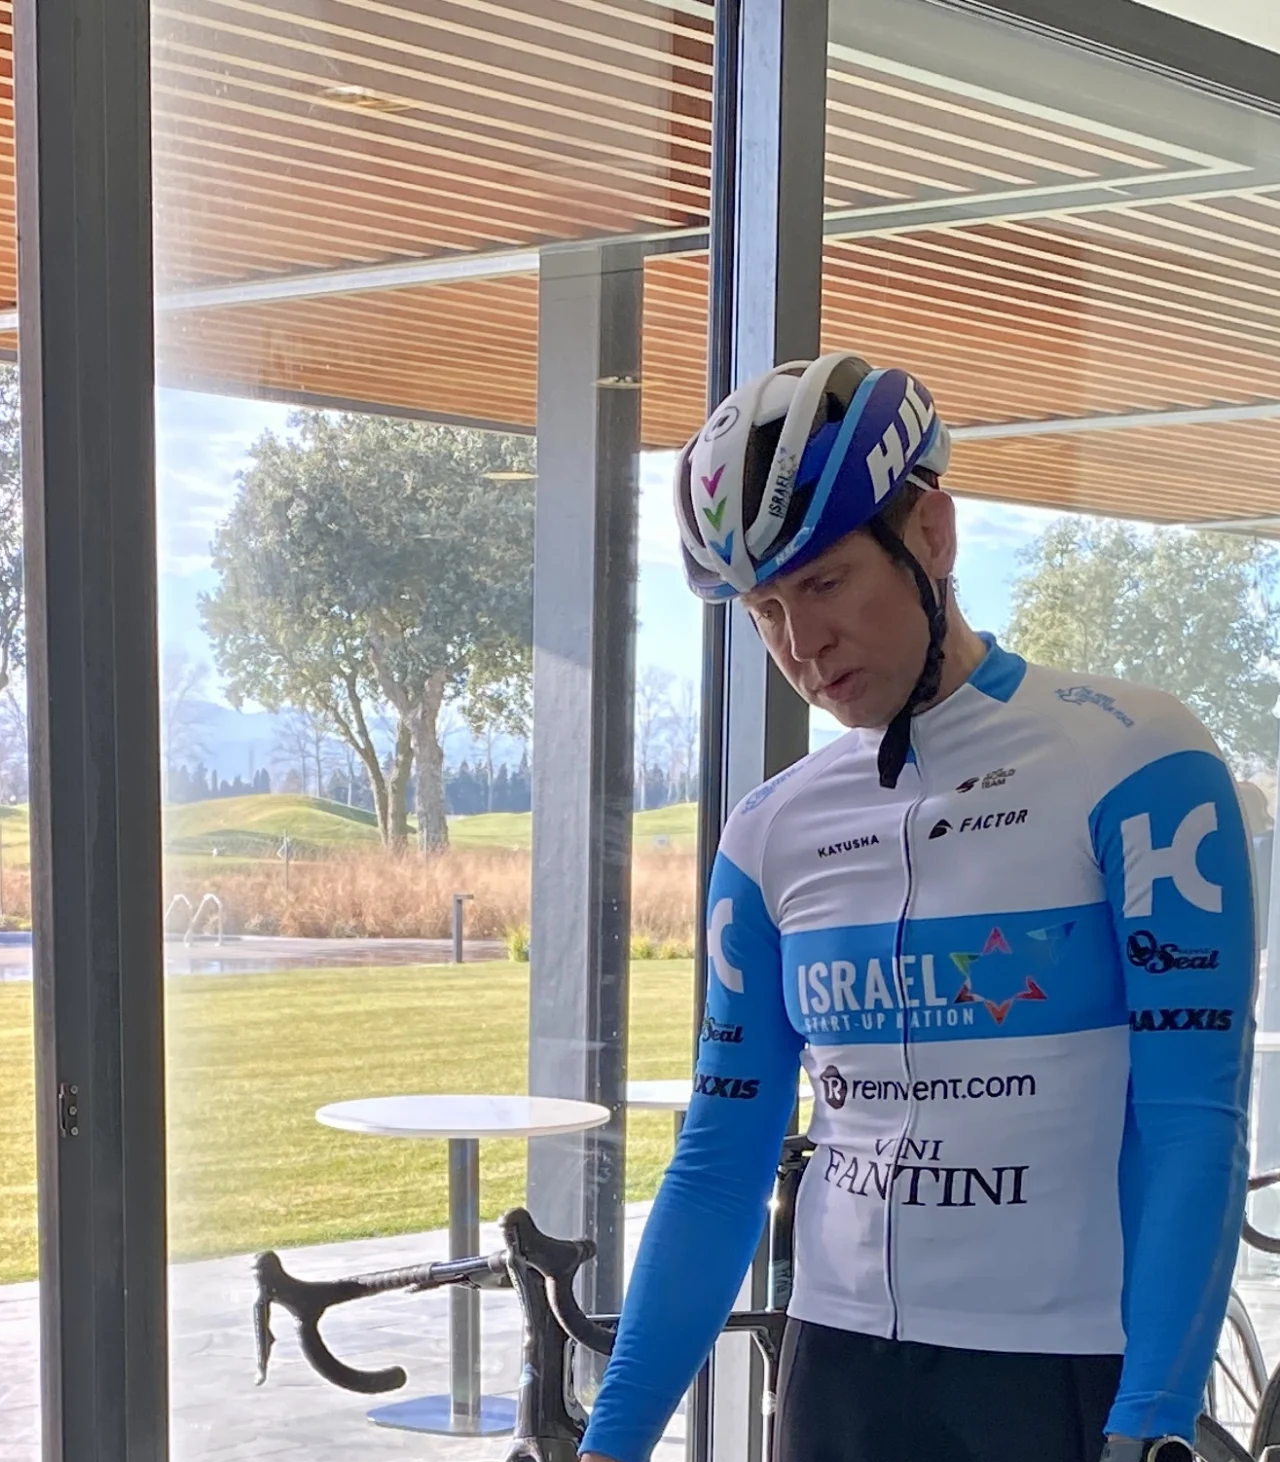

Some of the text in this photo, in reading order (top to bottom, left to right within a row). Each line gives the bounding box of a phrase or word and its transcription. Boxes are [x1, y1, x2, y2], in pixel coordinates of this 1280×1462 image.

[768, 472, 795, 518] ISRAEL
[959, 809, 1028, 833] FACTOR
[818, 834, 879, 858] KATUSHA
[797, 954, 947, 1015] ISRAEL
[804, 1012, 886, 1034] START-UP
[852, 1074, 1036, 1101] reinvent.com
[824, 1146, 1029, 1207] FANTINI
